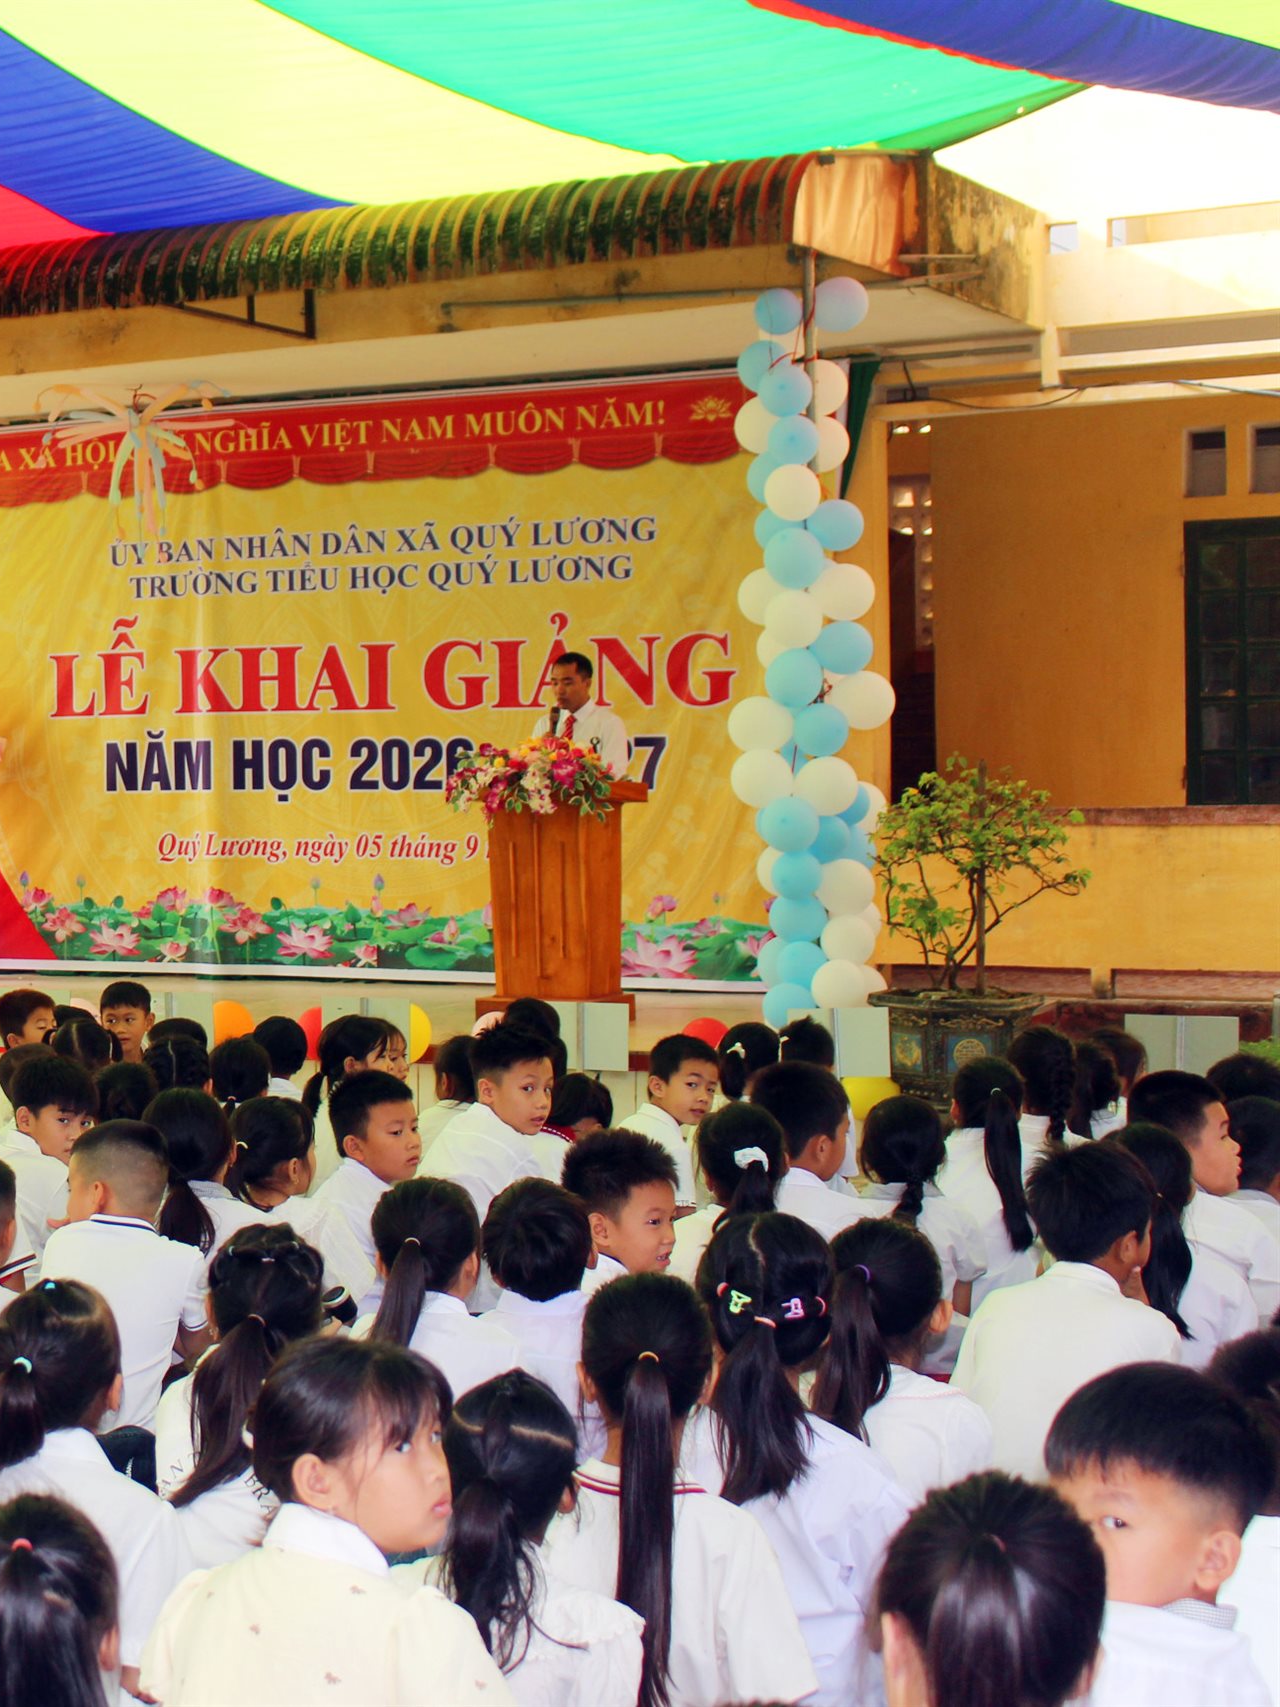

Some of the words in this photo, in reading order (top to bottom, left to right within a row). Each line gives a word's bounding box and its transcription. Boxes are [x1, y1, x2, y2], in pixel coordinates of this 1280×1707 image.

[195, 423, 292, 455] NGHĨA
[299, 418, 373, 452] VIỆT
[381, 414, 454, 442] NAM
[465, 402, 566, 437] MUÔN
[575, 397, 666, 430] NĂM!
[157, 538, 215, 564] BAN
[224, 528, 312, 560] NHÂN
[321, 524, 386, 556] DÂN
[396, 522, 440, 552] XÃ
[450, 516, 520, 554] QUÝ
[531, 517, 656, 546] LƯƠNG
[129, 566, 258, 599] TRƯỜNG
[349, 564, 418, 595] HỌC
[428, 554, 499, 591] QUÝ
[509, 554, 632, 584] LƯƠNG
[49, 615, 149, 718] LỄ
[174, 643, 397, 714] KHAI
[423, 612, 737, 711] GIẢNG
[105, 730, 212, 791] NĂM
[232, 738, 331, 802] HỌC
[158, 833, 200, 862] Quý
[205, 833, 288, 863] Lương,
[294, 833, 349, 864] ngày
[356, 833, 384, 858] 05
[389, 834, 457, 865] tháng
[465, 835, 478, 859] 9
